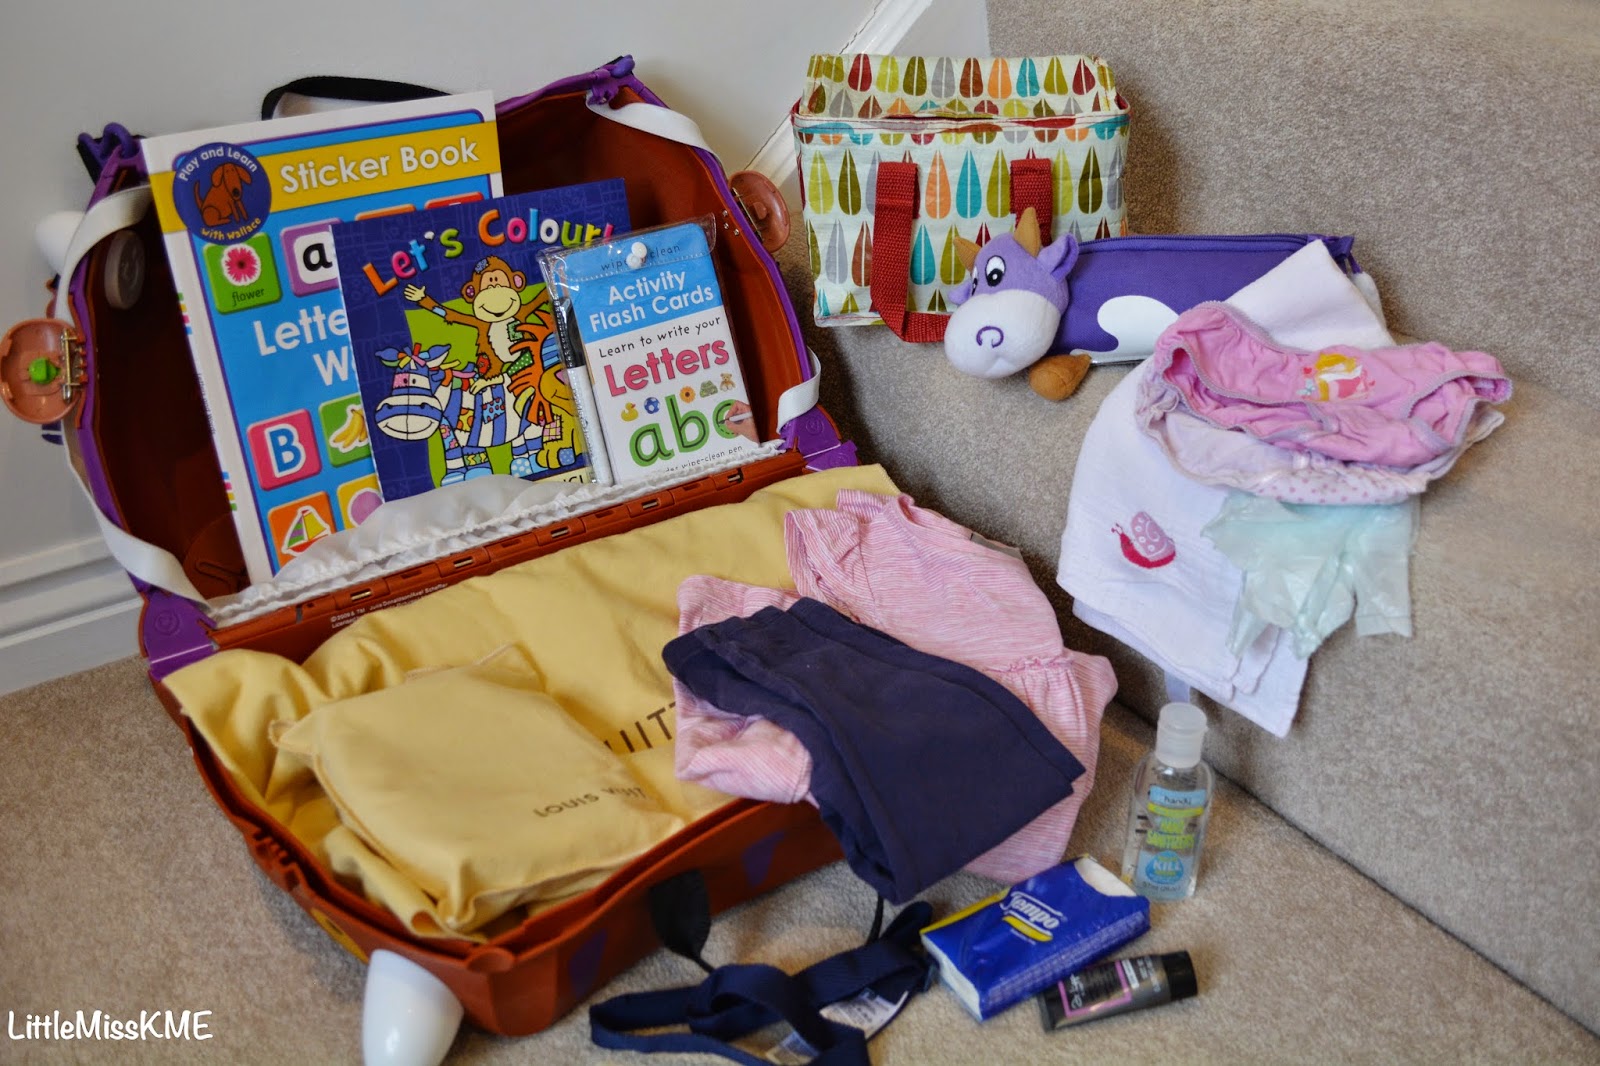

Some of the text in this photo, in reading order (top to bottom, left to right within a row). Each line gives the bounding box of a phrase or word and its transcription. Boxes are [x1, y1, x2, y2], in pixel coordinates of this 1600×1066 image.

[178, 146, 258, 181] Play and Learn
[280, 137, 480, 193] Sticker Book
[201, 228, 225, 240] with
[302, 243, 333, 271] a
[362, 228, 464, 296] Let's
[231, 286, 265, 306] flower
[589, 285, 714, 333] Flash Cards
[608, 271, 686, 306] Activity
[253, 305, 349, 356] Lette
[599, 316, 721, 359] Learn to write your
[603, 339, 730, 397] Letters
[265, 424, 306, 478] B
[532, 793, 600, 818] LOUIS
[1000, 891, 1062, 930] Tempo
